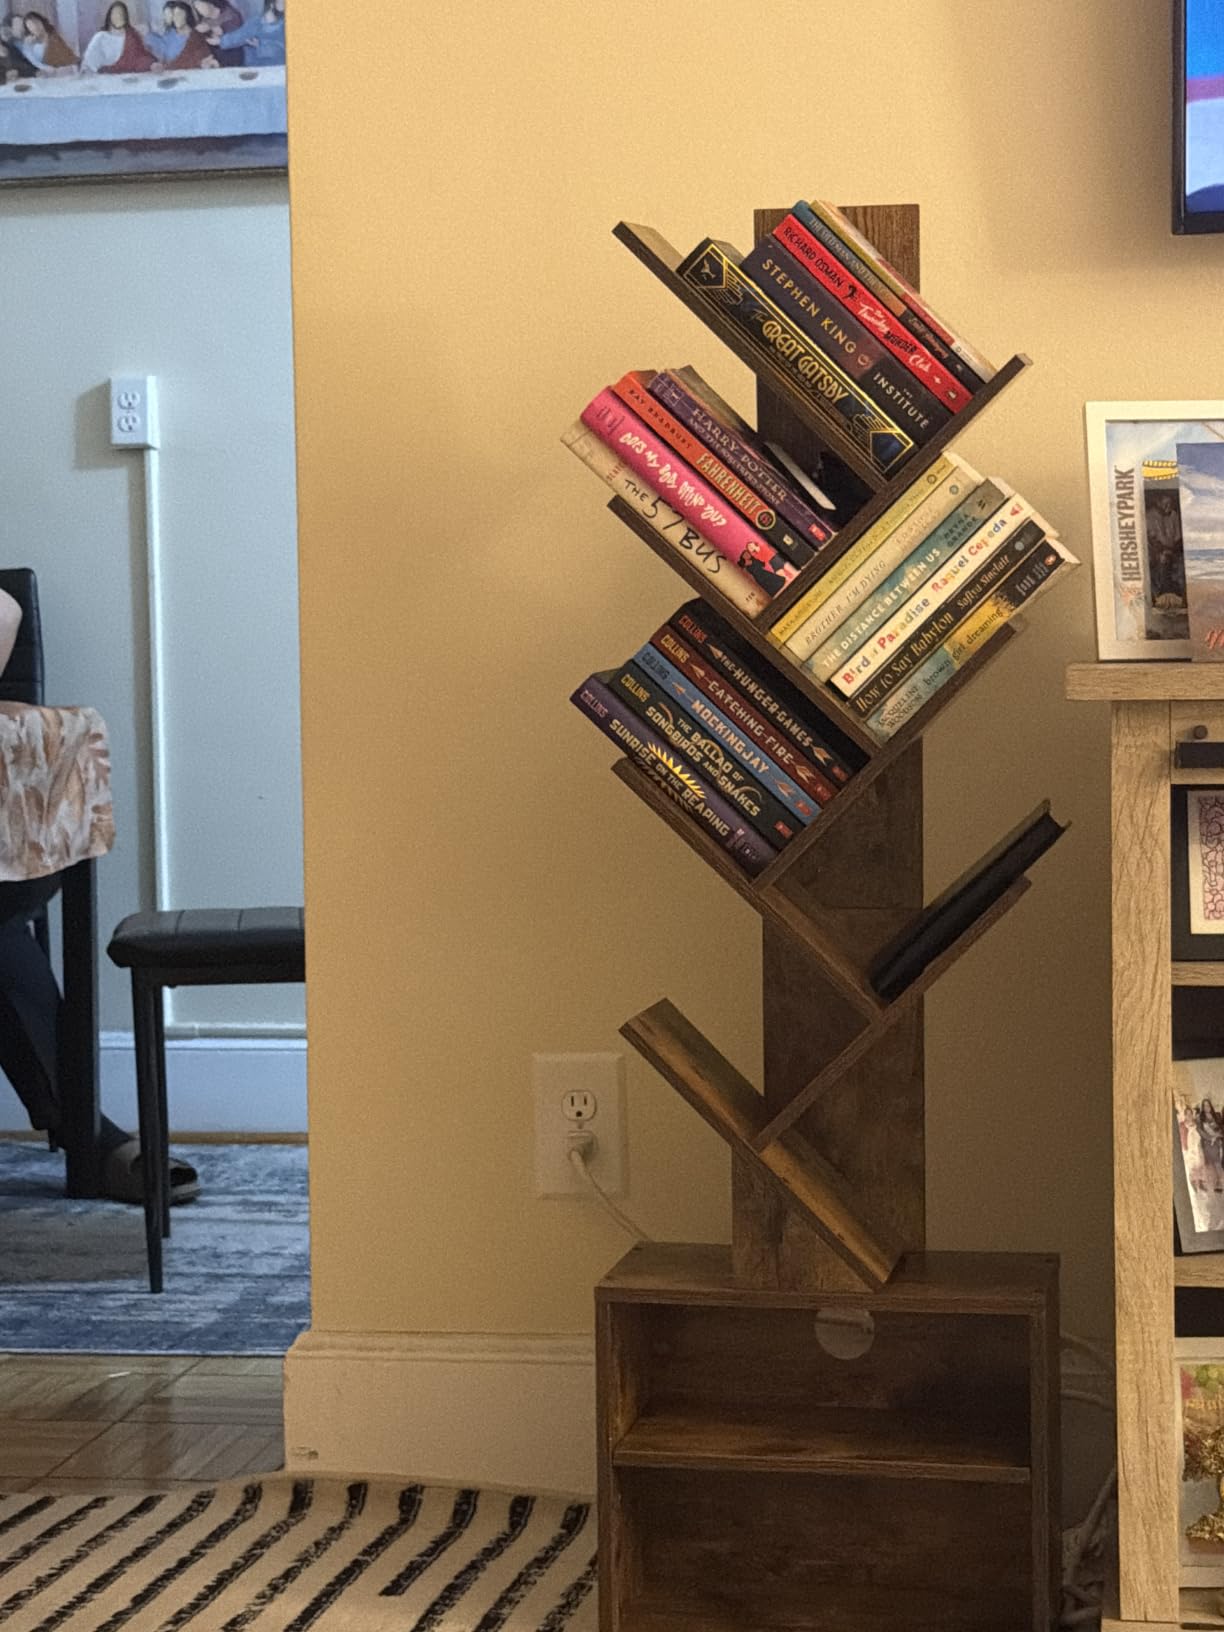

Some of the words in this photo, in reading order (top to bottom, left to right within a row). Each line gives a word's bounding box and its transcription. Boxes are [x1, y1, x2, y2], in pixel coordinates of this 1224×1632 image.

[780, 225, 818, 262] RICHARD
[813, 257, 845, 288] OSMAN
[760, 257, 821, 318] STEPHEN
[819, 316, 858, 356] KING
[757, 316, 804, 363] GREAT
[793, 352, 849, 407] GATSBY
[882, 330, 918, 355] MURDER
[906, 351, 933, 374] Club
[627, 388, 646, 406] RAY
[646, 406, 693, 450] BRADBURY
[872, 371, 930, 429] INSTITUTE
[618, 428, 648, 455] DOES
[654, 462, 684, 492] BODY
[695, 503, 728, 531] YOU?
[690, 407, 739, 454] HARRY
[739, 453, 789, 501] POTTER
[694, 451, 762, 516] FAHRENHEIT
[621, 476, 649, 503] THE
[641, 493, 685, 534] 57
[676, 526, 729, 576] BUS
[945, 515, 978, 548] GRANDE
[1114, 467, 1142, 582] HERSHEYPARK
[822, 647, 842, 668] THE
[839, 603, 887, 650] DISTANCE
[883, 560, 928, 606] BETWEEN
[925, 546, 941, 563] US
[858, 558, 887, 590] DYING
[930, 554, 969, 594] Raquel
[979, 553, 1012, 586] Sinclair
[659, 633, 690, 664] COLLINS
[677, 614, 707, 644] COLLINS
[841, 653, 871, 685] Bird
[876, 595, 931, 651] Paradise
[854, 683, 882, 712] How
[878, 668, 897, 689] to
[889, 649, 916, 677] Say
[908, 608, 956, 657] Babylon
[922, 656, 952, 686] brown
[949, 640, 967, 661] girl
[963, 606, 1005, 645] dreaming
[578, 688, 609, 719] COLLINS
[619, 673, 650, 703] COLLINS
[706, 679, 765, 737] CATCHING
[764, 735, 794, 765] FIRE
[719, 654, 735, 671] THE
[731, 667, 779, 714] HUNGER
[775, 710, 813, 749] GAMES
[643, 705, 704, 762] SONGBIRDS
[701, 760, 719, 777] AND
[716, 774, 761, 817] SNAKES
[676, 717, 692, 734] THE
[689, 731, 733, 774] BALLAD
[731, 770, 744, 783] OF
[690, 698, 770, 776] MOCKINGJAY
[607, 717, 657, 766] SUNRISE
[665, 773, 683, 791] THE
[680, 787, 731, 837] REAPING
